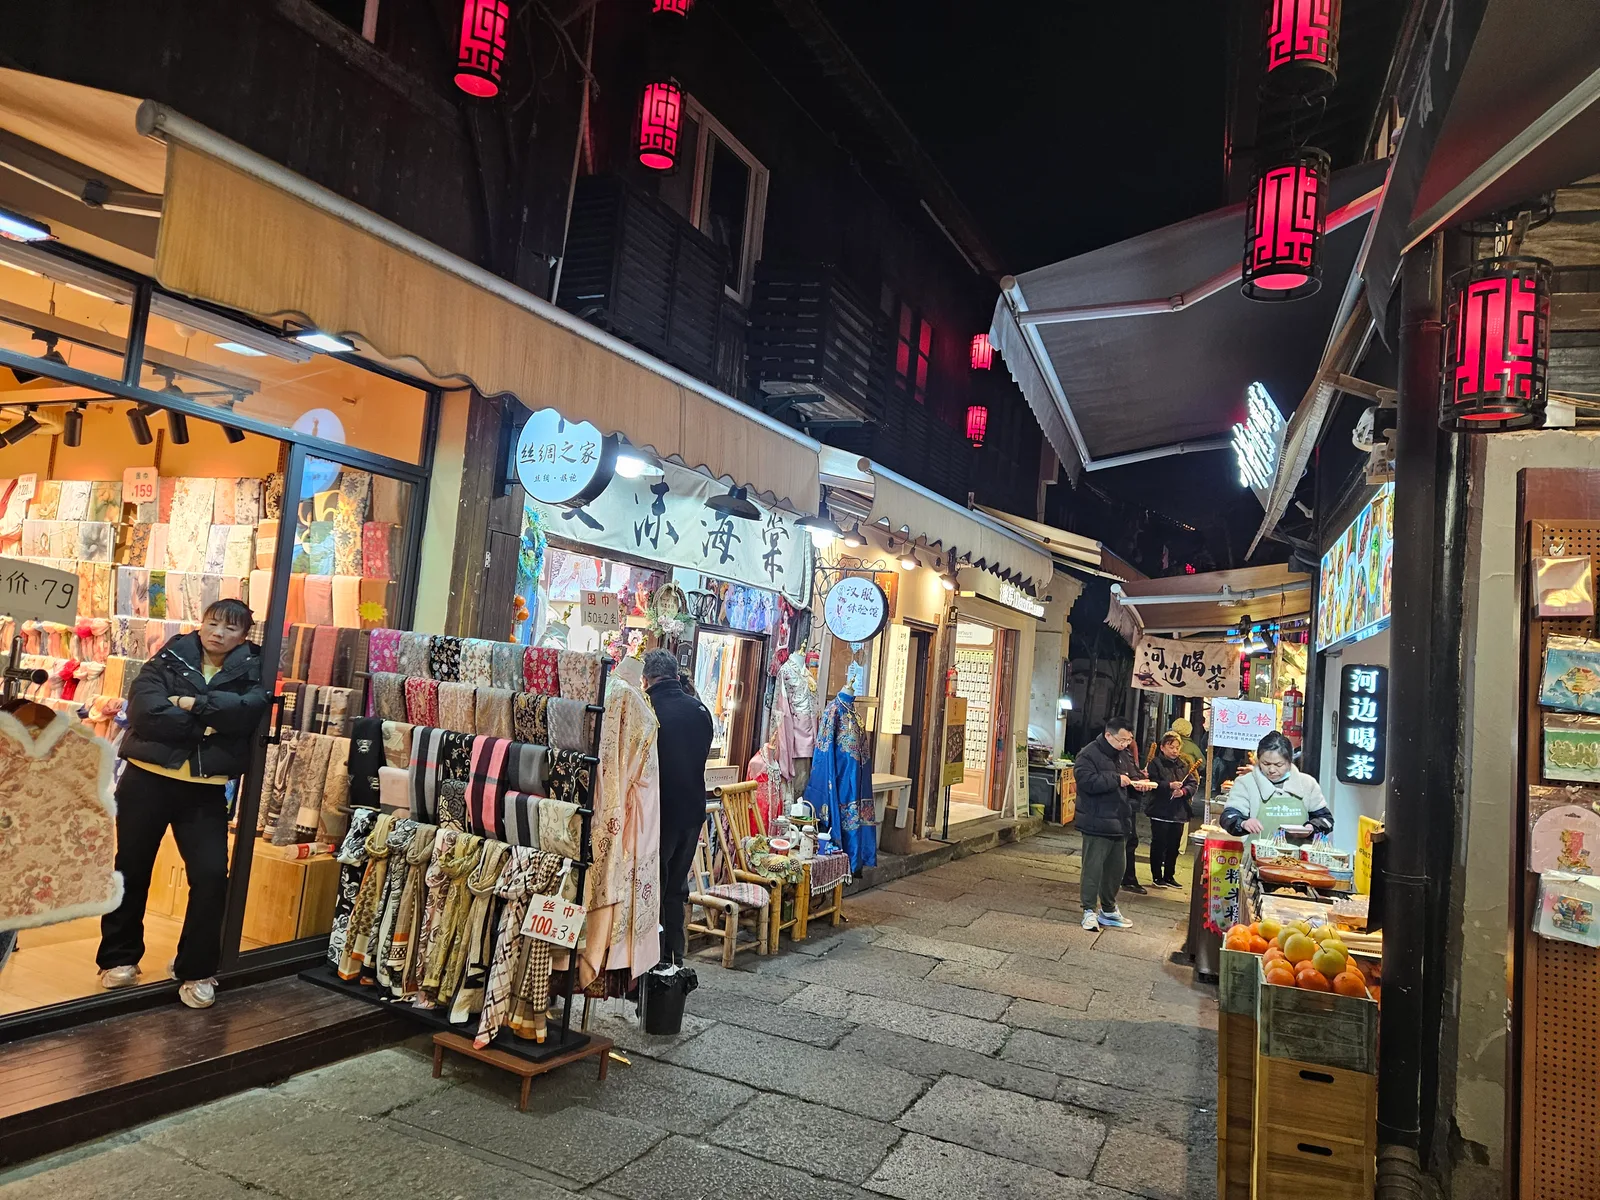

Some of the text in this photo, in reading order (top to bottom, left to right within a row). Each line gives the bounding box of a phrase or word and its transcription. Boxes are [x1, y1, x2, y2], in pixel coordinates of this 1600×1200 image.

[519, 441, 598, 465] 丝绸之家
[0, 570, 75, 609] 价:79
[587, 592, 610, 606] 围巾
[846, 586, 875, 603] 汉服
[1144, 643, 1227, 691] 河边喝茶
[1216, 709, 1271, 726] 葱包桧
[1346, 669, 1379, 780] 河边喝茶
[542, 900, 575, 920] 丝巾
